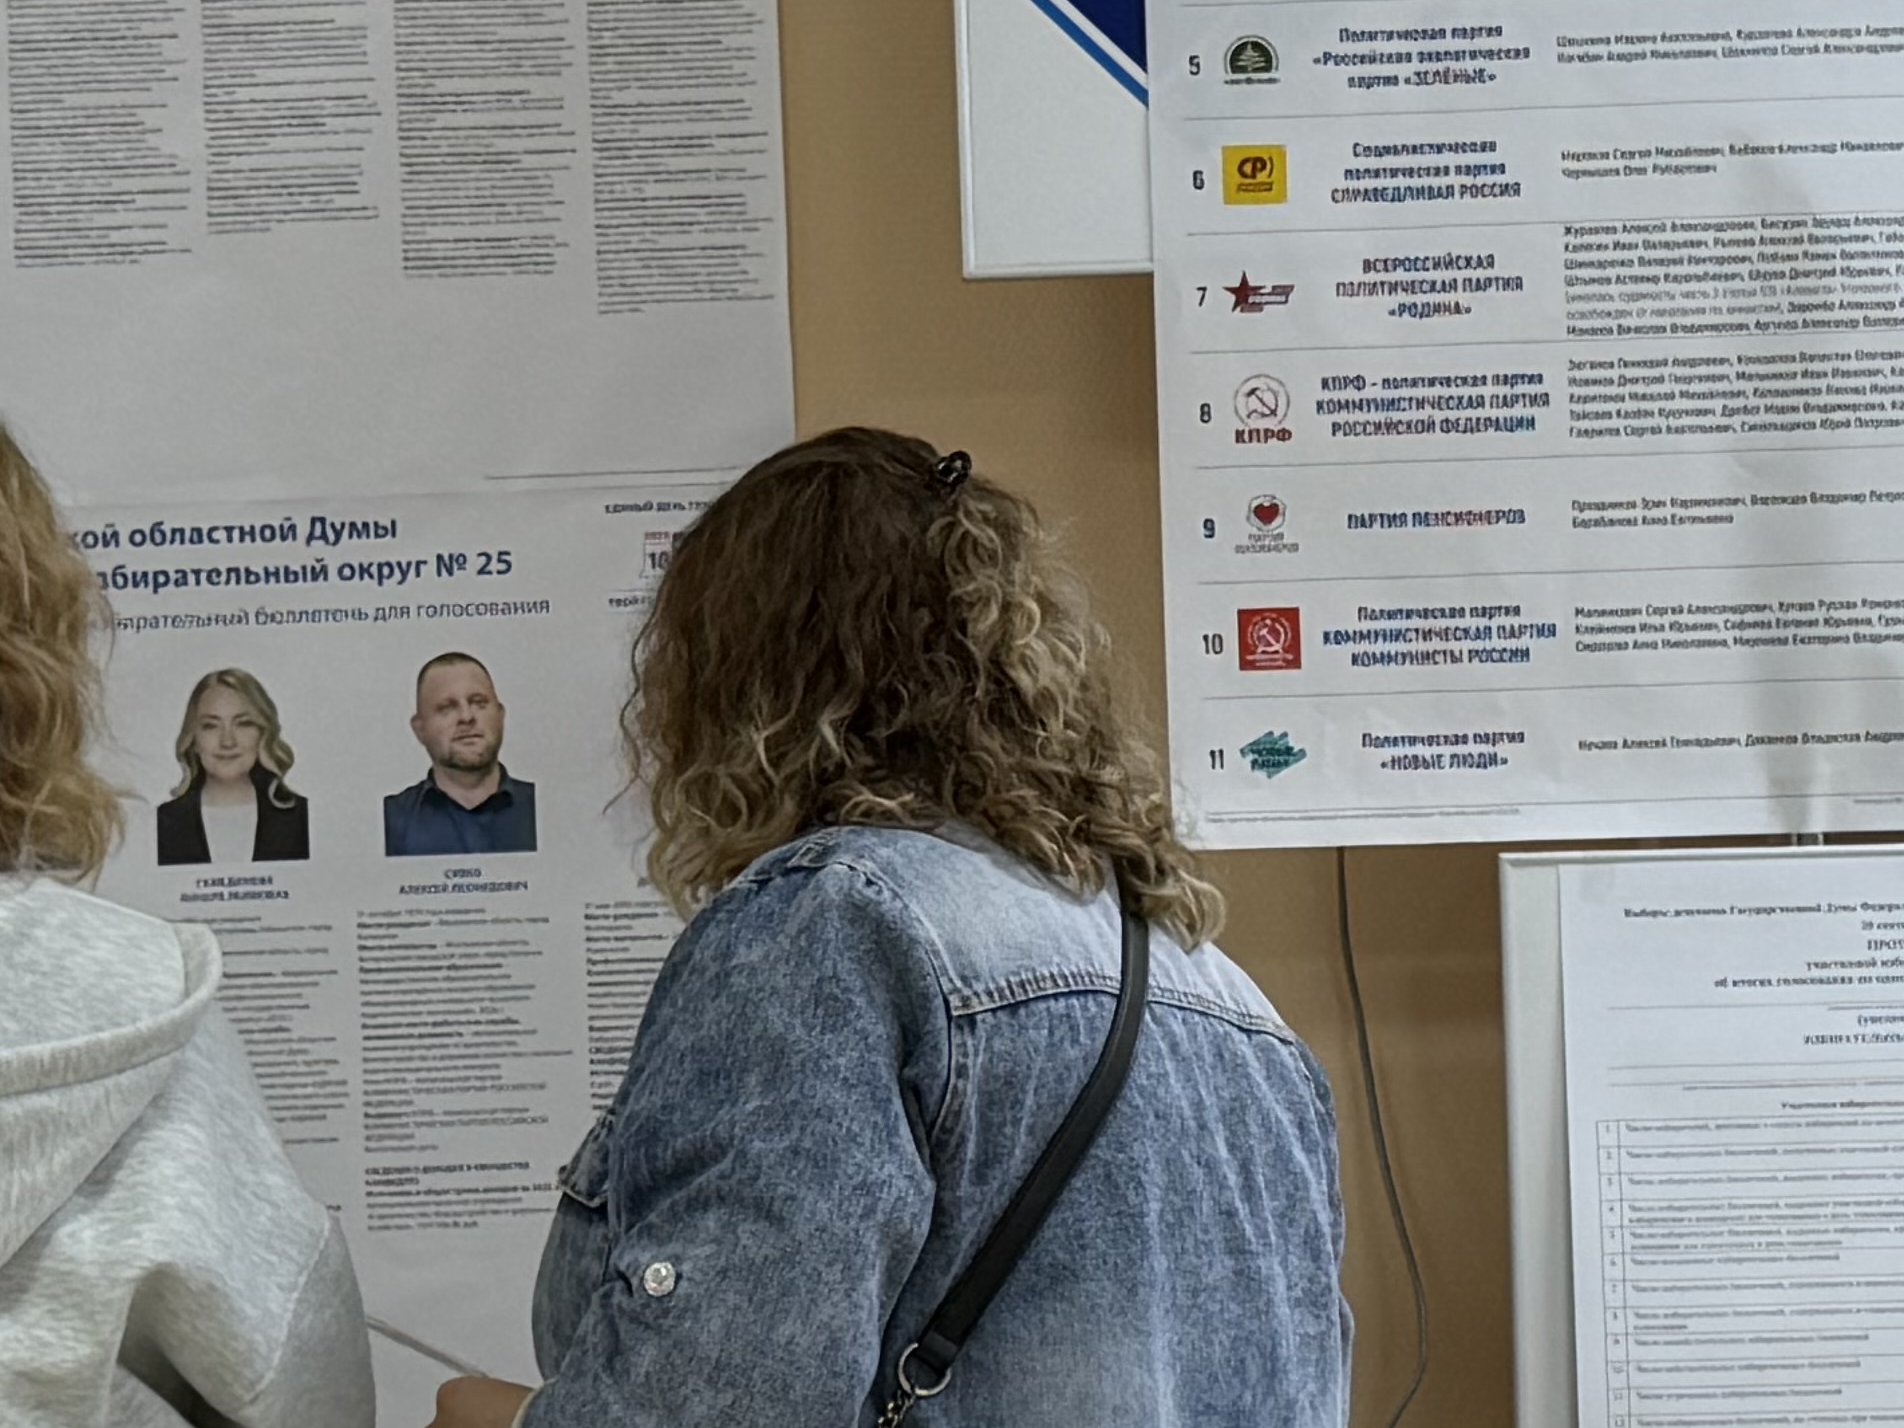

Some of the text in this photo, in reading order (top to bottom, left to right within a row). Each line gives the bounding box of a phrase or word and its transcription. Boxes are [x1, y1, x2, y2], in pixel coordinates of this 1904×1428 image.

[1189, 55, 1200, 75] 5
[1193, 170, 1204, 190] 6
[1197, 287, 1207, 306] 7
[1200, 403, 1211, 423] 8
[1235, 428, 1292, 443] КПРФ
[128, 516, 297, 548] областной
[305, 515, 397, 547] Думы
[1203, 519, 1215, 538] 9
[97, 550, 513, 593] збирательный округ № 25
[1203, 634, 1223, 654] 10
[1210, 749, 1224, 769] 11
